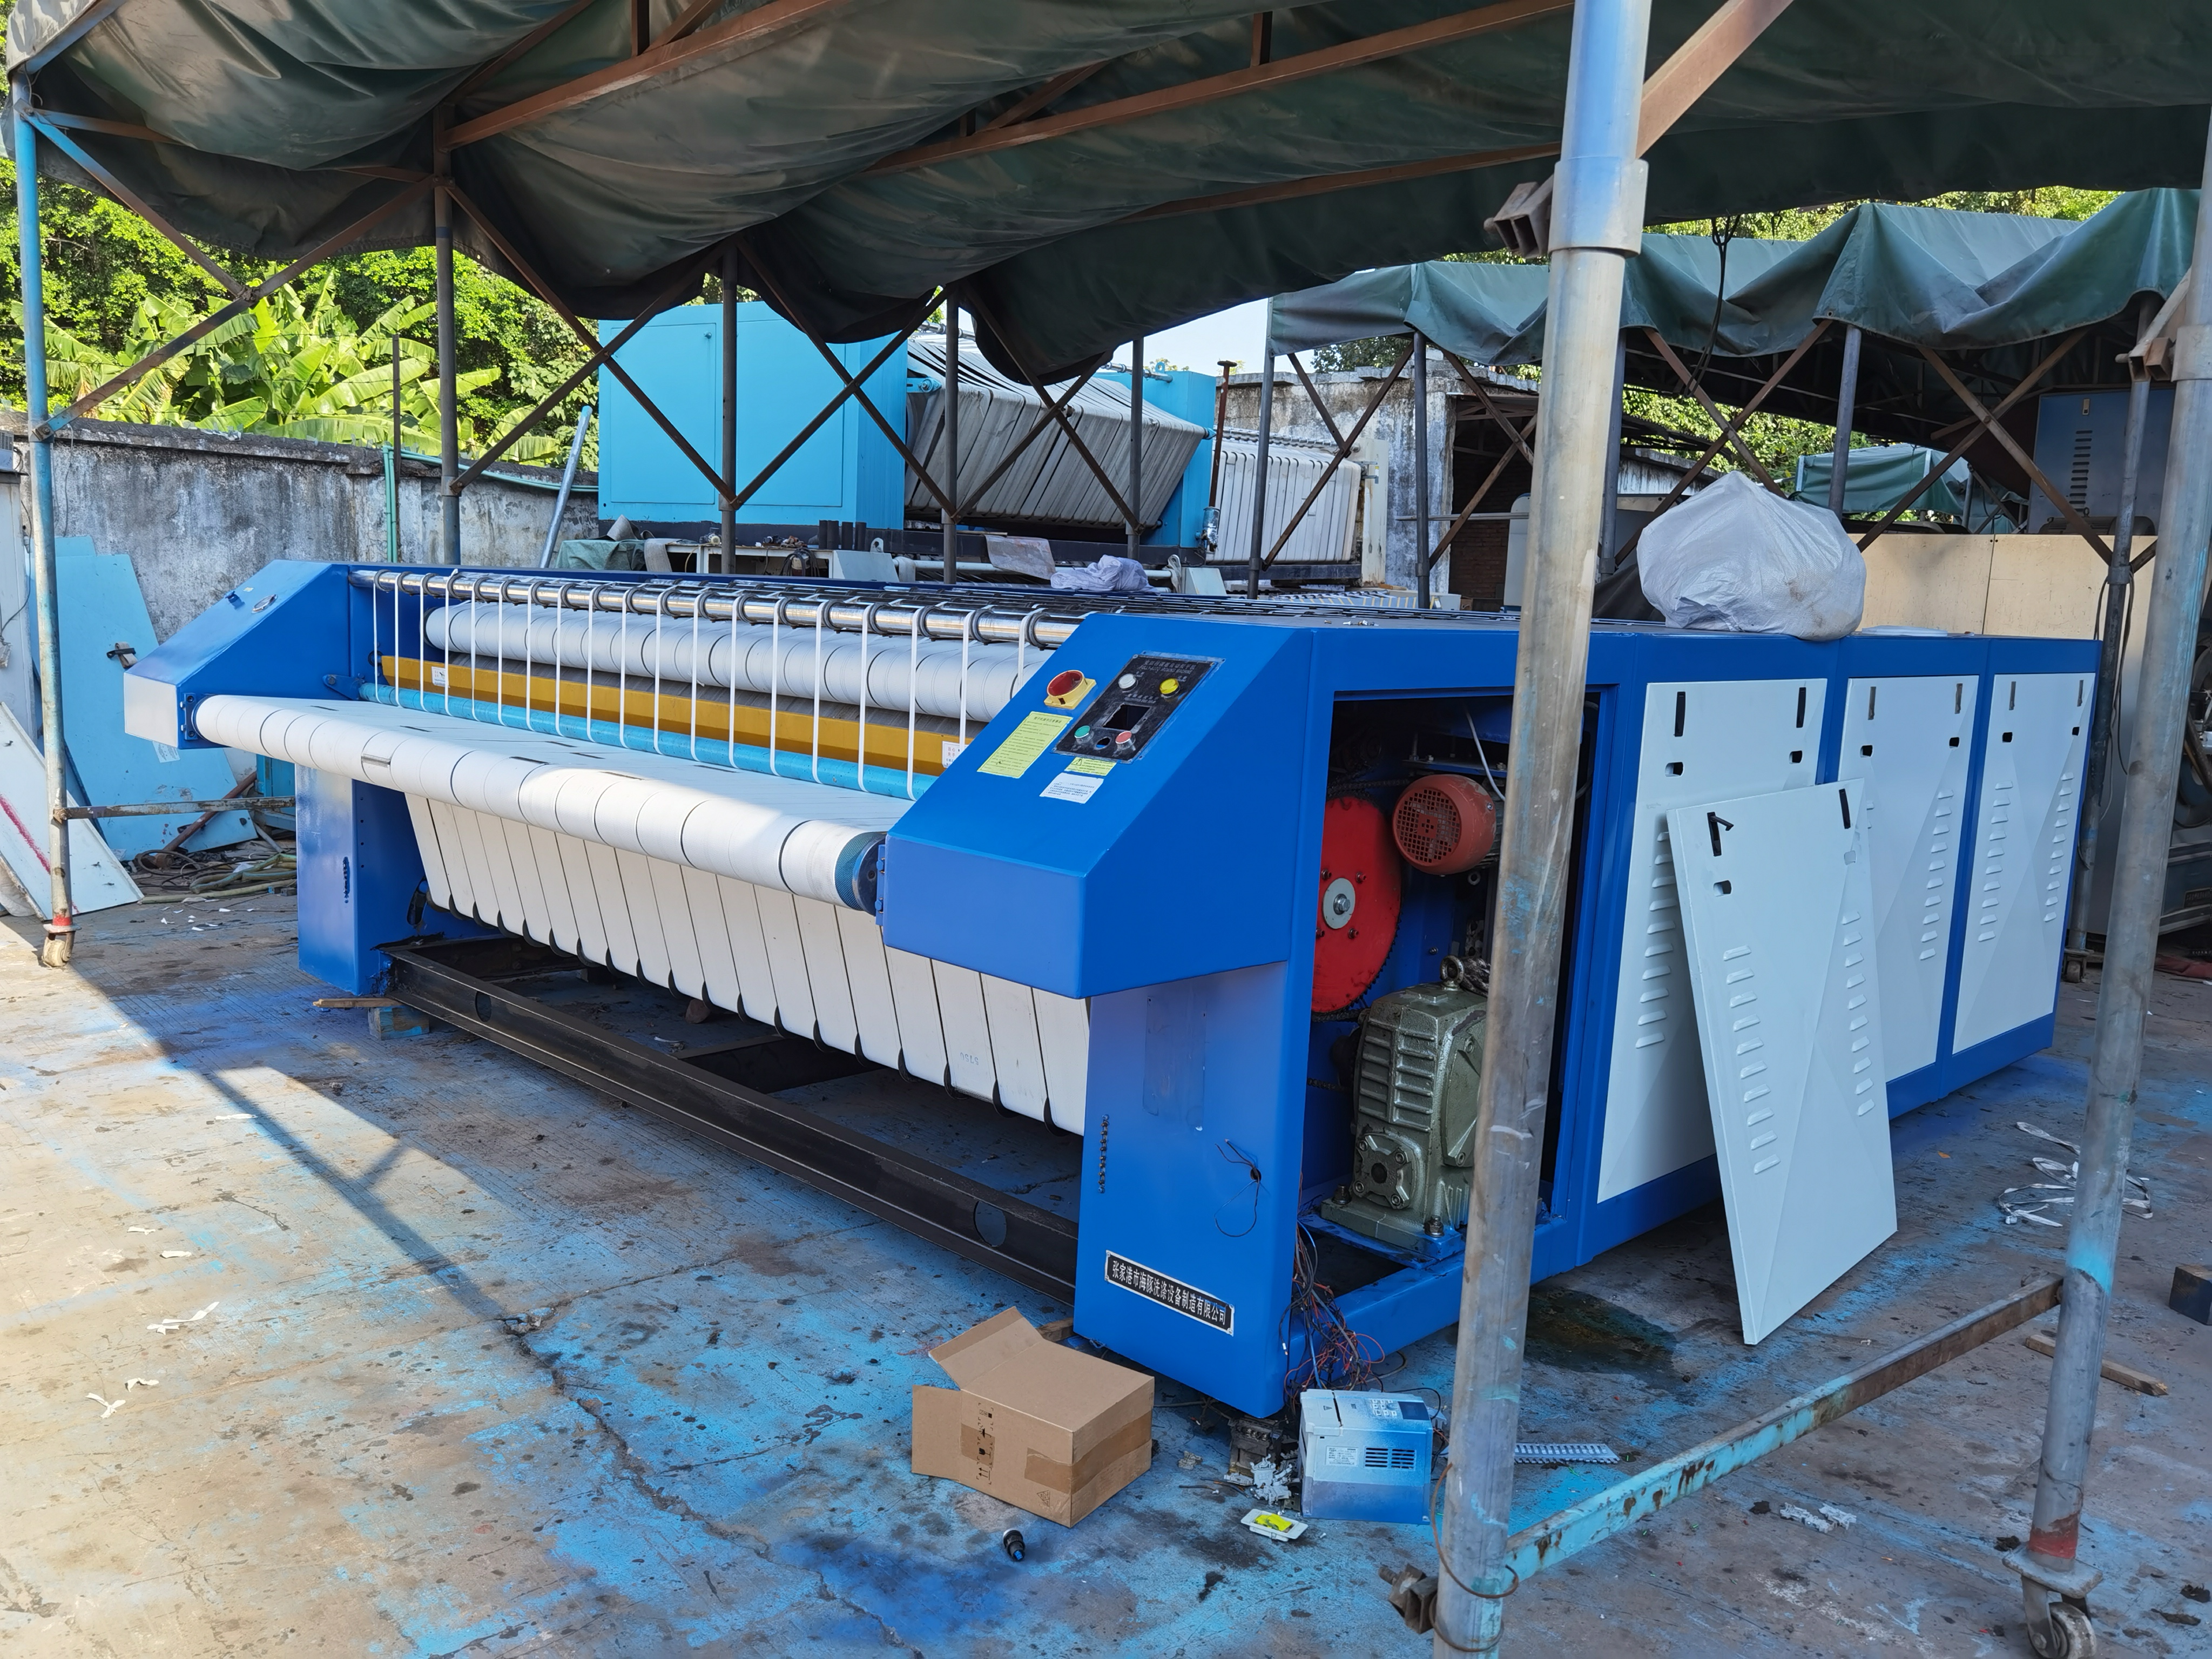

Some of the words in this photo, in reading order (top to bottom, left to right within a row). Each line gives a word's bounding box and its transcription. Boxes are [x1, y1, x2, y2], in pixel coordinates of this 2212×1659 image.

[1112, 1259, 1226, 1326] 张家港市海豚洗涤设备制造有限公司
